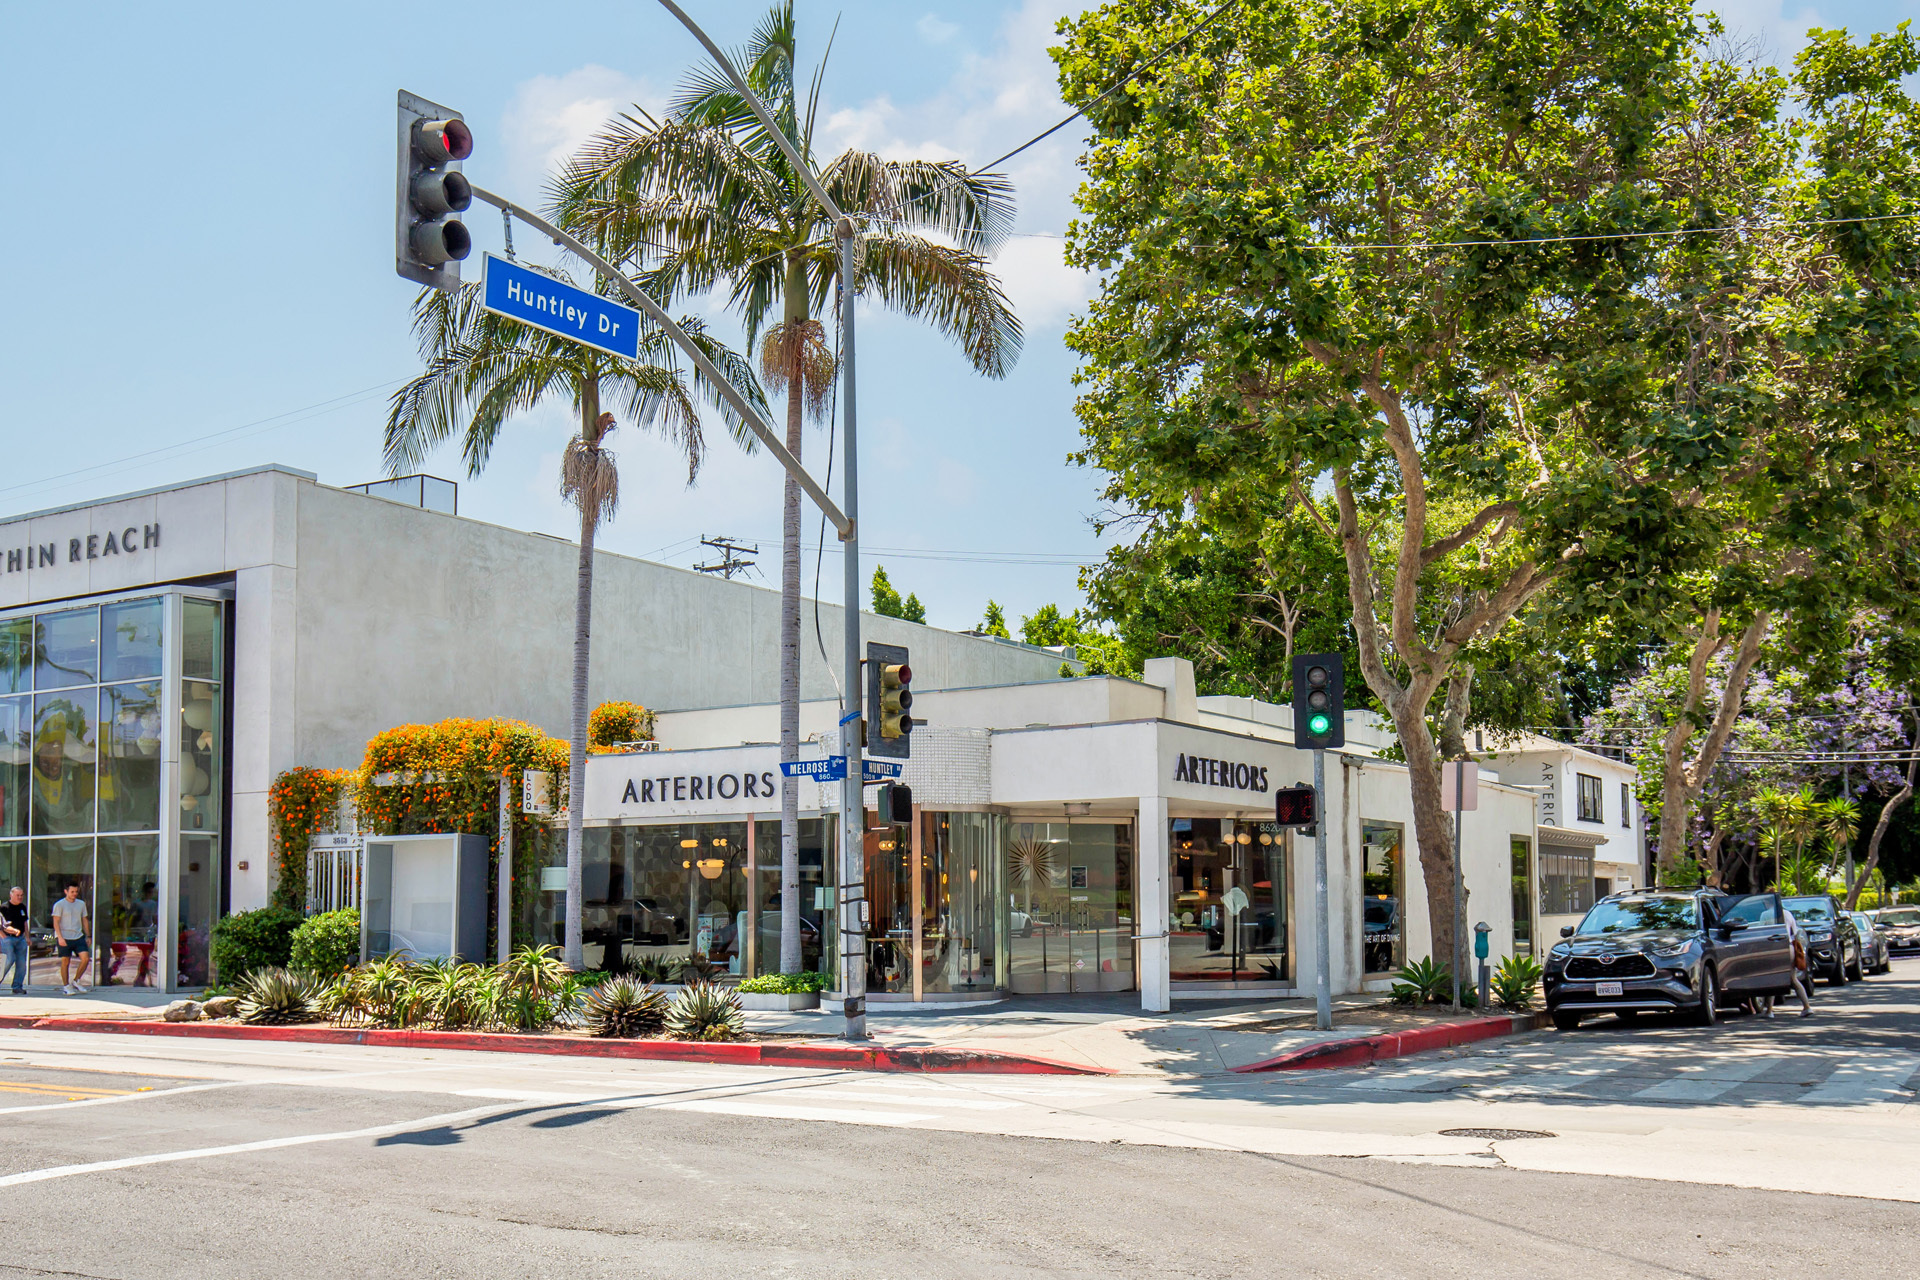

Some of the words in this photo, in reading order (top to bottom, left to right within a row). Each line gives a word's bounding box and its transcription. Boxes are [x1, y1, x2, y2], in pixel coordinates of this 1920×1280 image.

[507, 279, 588, 330] Huntley
[598, 313, 620, 337] Dr
[68, 522, 159, 563] REACH
[790, 761, 829, 775] MELROSE
[868, 762, 894, 775] HUNTLEY
[1176, 752, 1269, 793] ARTERIORS
[621, 771, 775, 803] ARTERIORS
